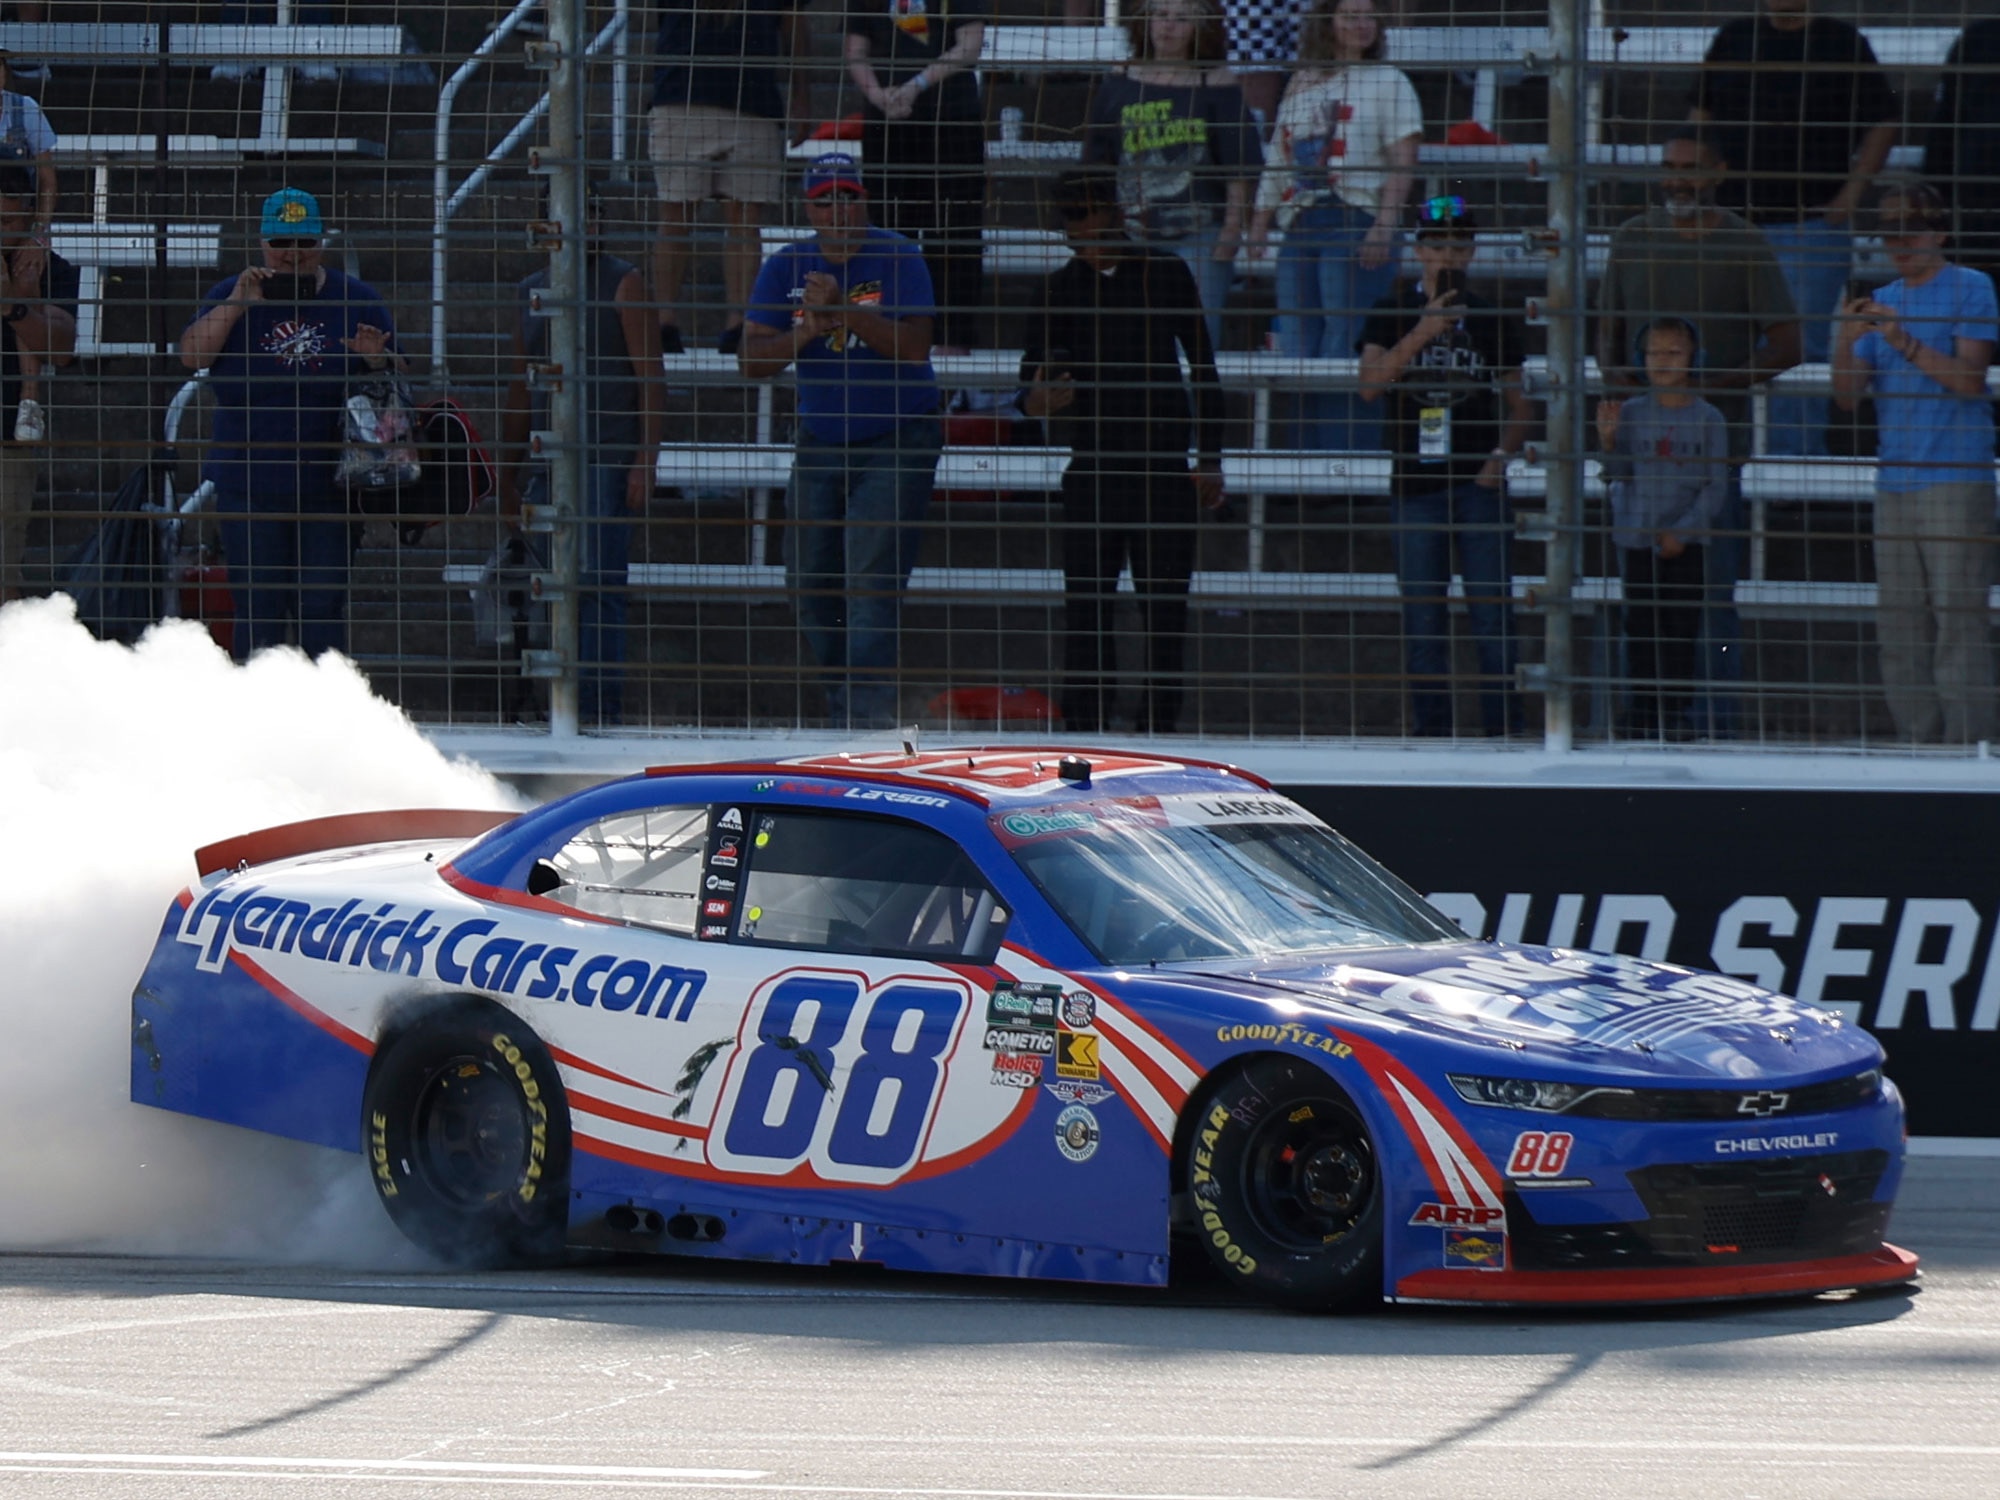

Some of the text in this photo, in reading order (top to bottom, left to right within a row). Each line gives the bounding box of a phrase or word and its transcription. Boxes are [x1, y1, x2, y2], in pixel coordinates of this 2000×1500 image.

[1197, 798, 1303, 817] LARSON
[707, 902, 725, 913] SEM
[995, 991, 1033, 1015] O'Reilly
[1216, 1022, 1353, 1060] GOODYEAR
[724, 976, 962, 1168] 88
[994, 1054, 1043, 1077] Holley
[990, 1071, 1036, 1089] MSD
[492, 1033, 548, 1204] GOODYEAR
[372, 1109, 399, 1198] EAGLE
[1507, 1131, 1574, 1176] 88
[1714, 1131, 1839, 1154] CHEVROLET
[1193, 1104, 1258, 1275] GOODYEAR
[1414, 1204, 1504, 1225] ARP
